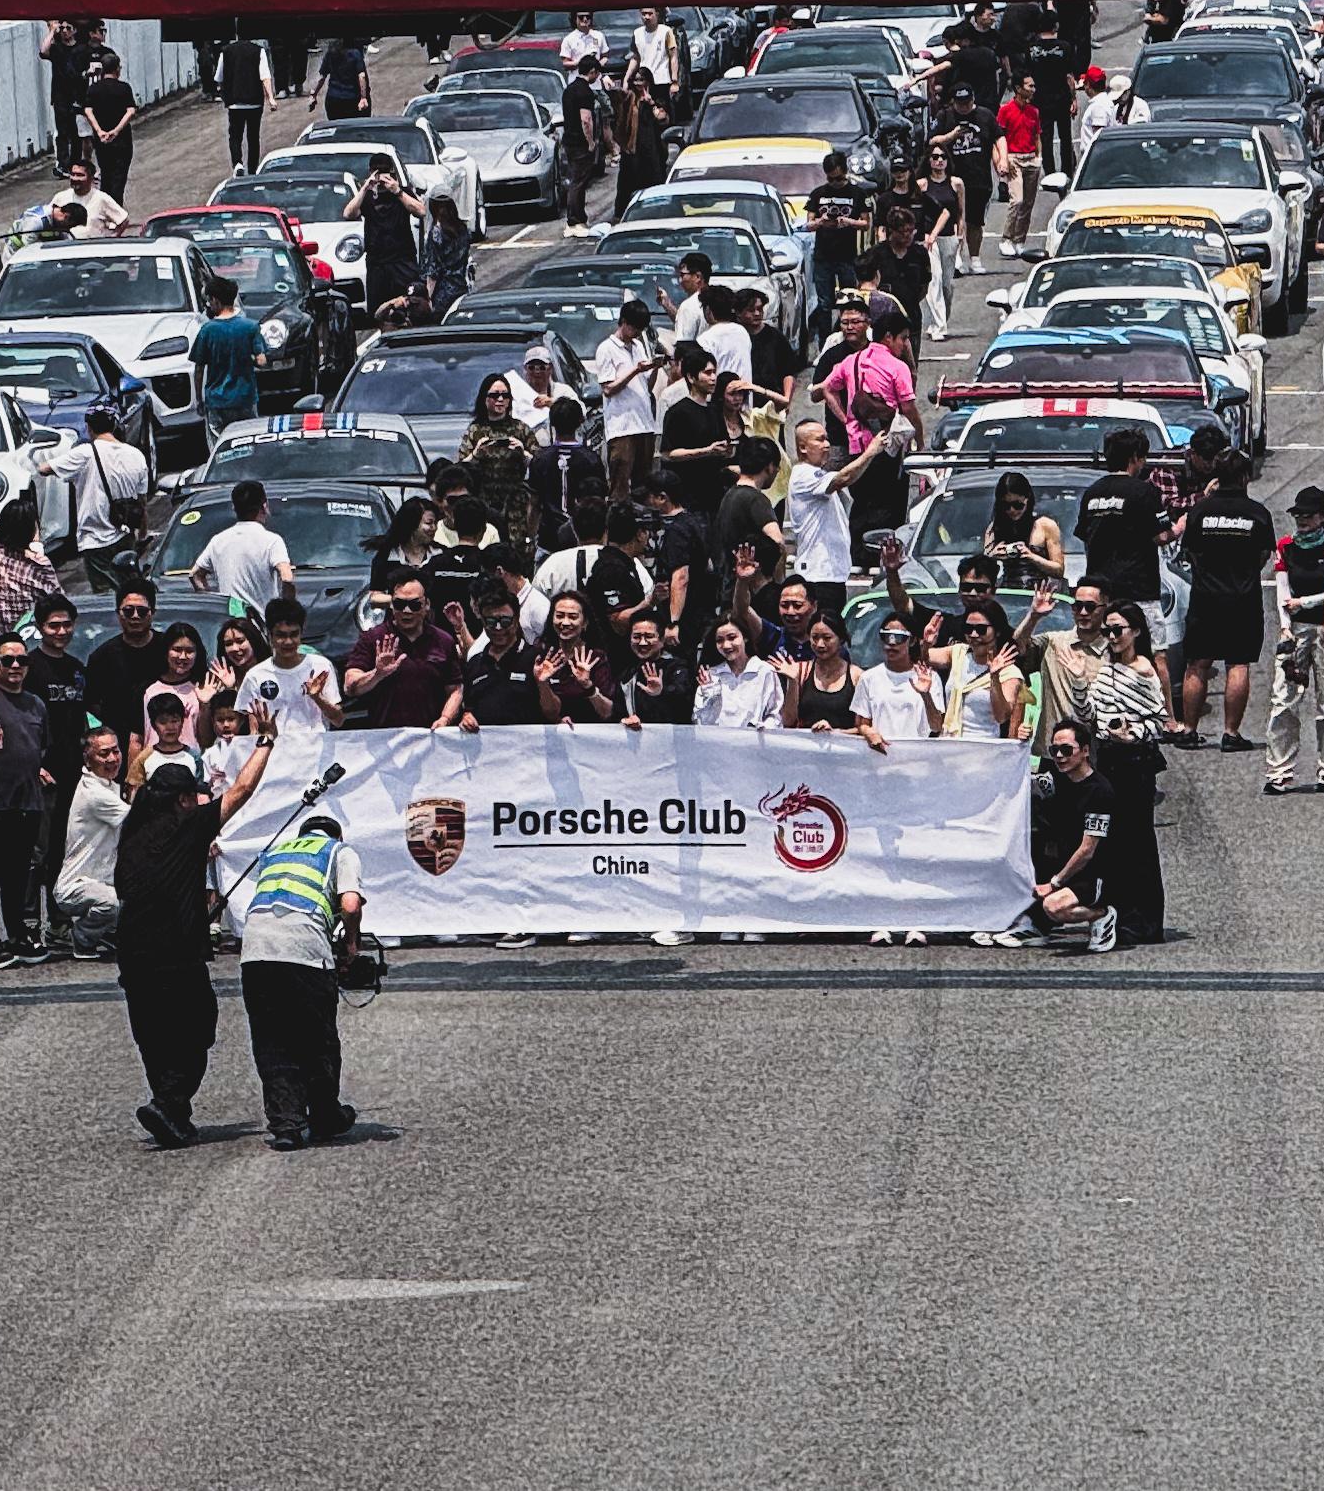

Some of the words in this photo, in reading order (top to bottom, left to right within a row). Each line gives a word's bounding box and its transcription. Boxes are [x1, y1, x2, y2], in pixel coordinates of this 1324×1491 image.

[493, 799, 649, 836] Porsche
[659, 798, 746, 835] Club
[793, 831, 824, 843] Club
[592, 855, 649, 875] China
